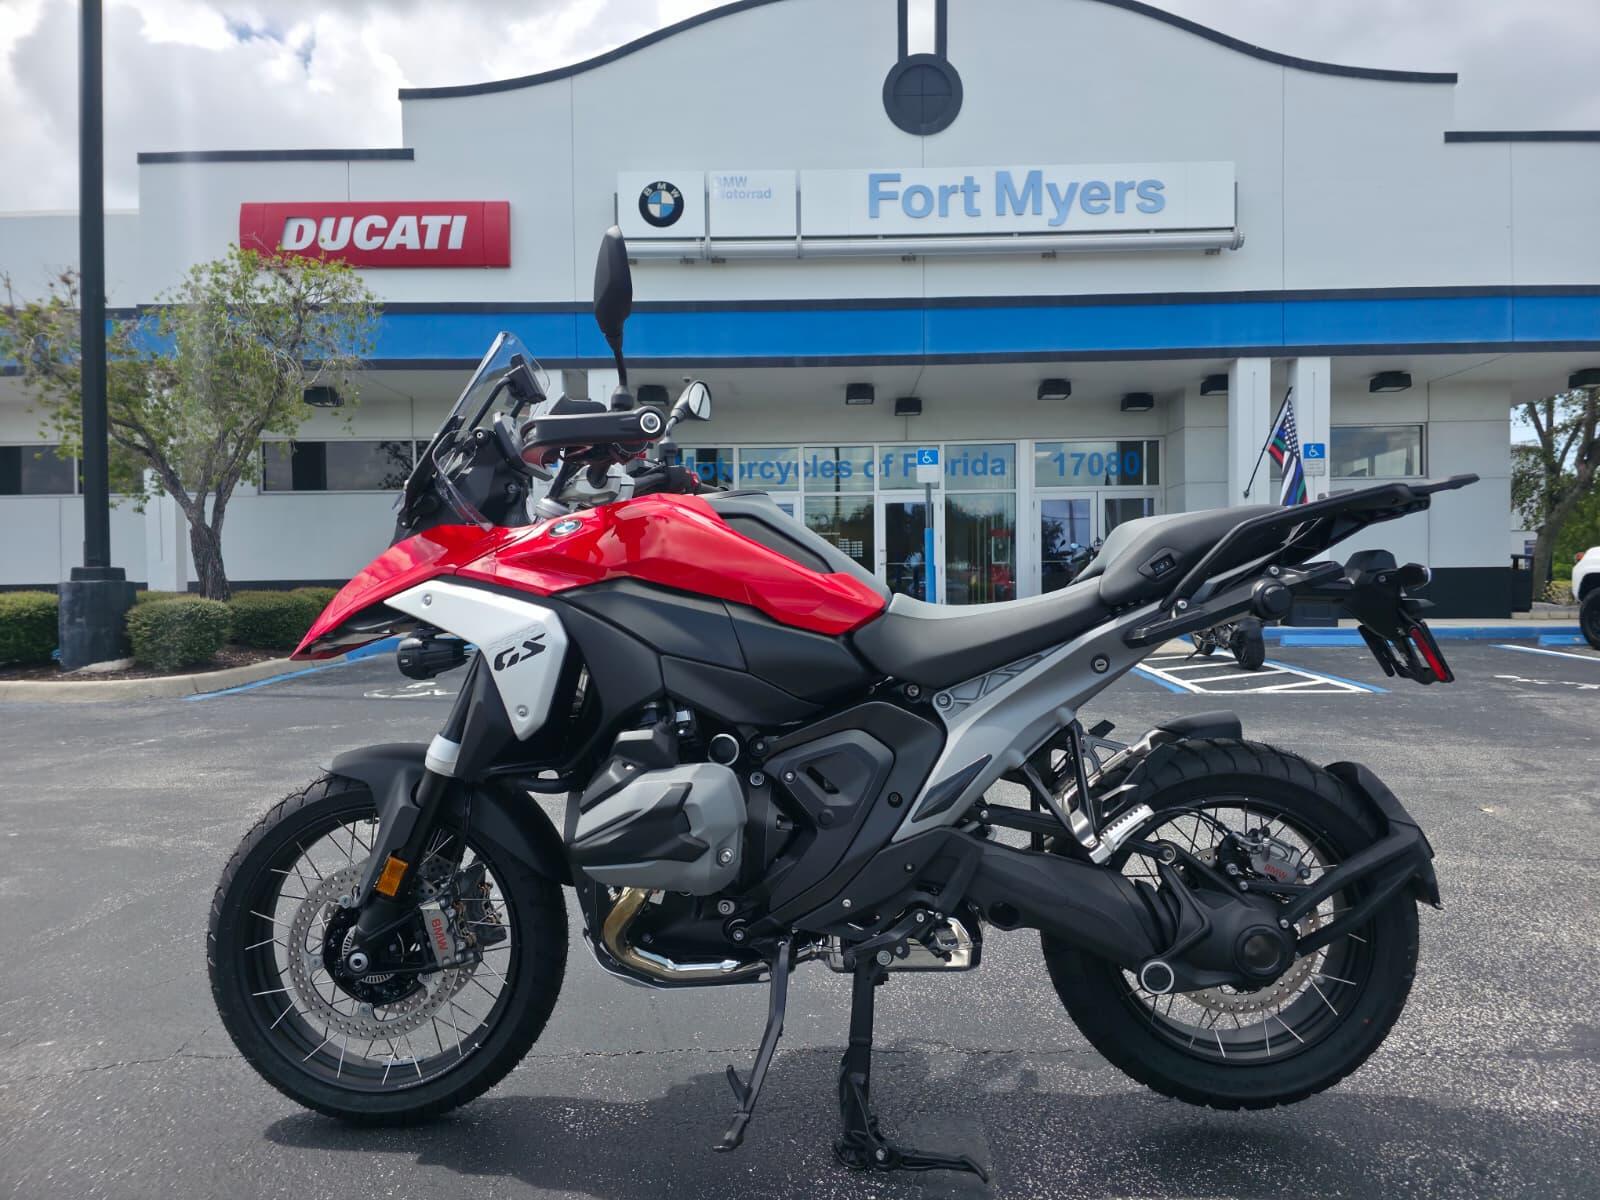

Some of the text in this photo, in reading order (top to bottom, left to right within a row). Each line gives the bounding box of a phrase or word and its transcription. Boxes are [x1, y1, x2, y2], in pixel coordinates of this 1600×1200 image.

[642, 182, 681, 198] BMW
[714, 186, 772, 200] otorrad
[868, 170, 1166, 227] Fort Myers
[281, 215, 468, 251] DUCATI
[863, 453, 894, 479] of
[903, 450, 1006, 478] Frida
[1052, 451, 1140, 478] 17080
[494, 632, 546, 671] GS
[431, 918, 449, 950] BMW
